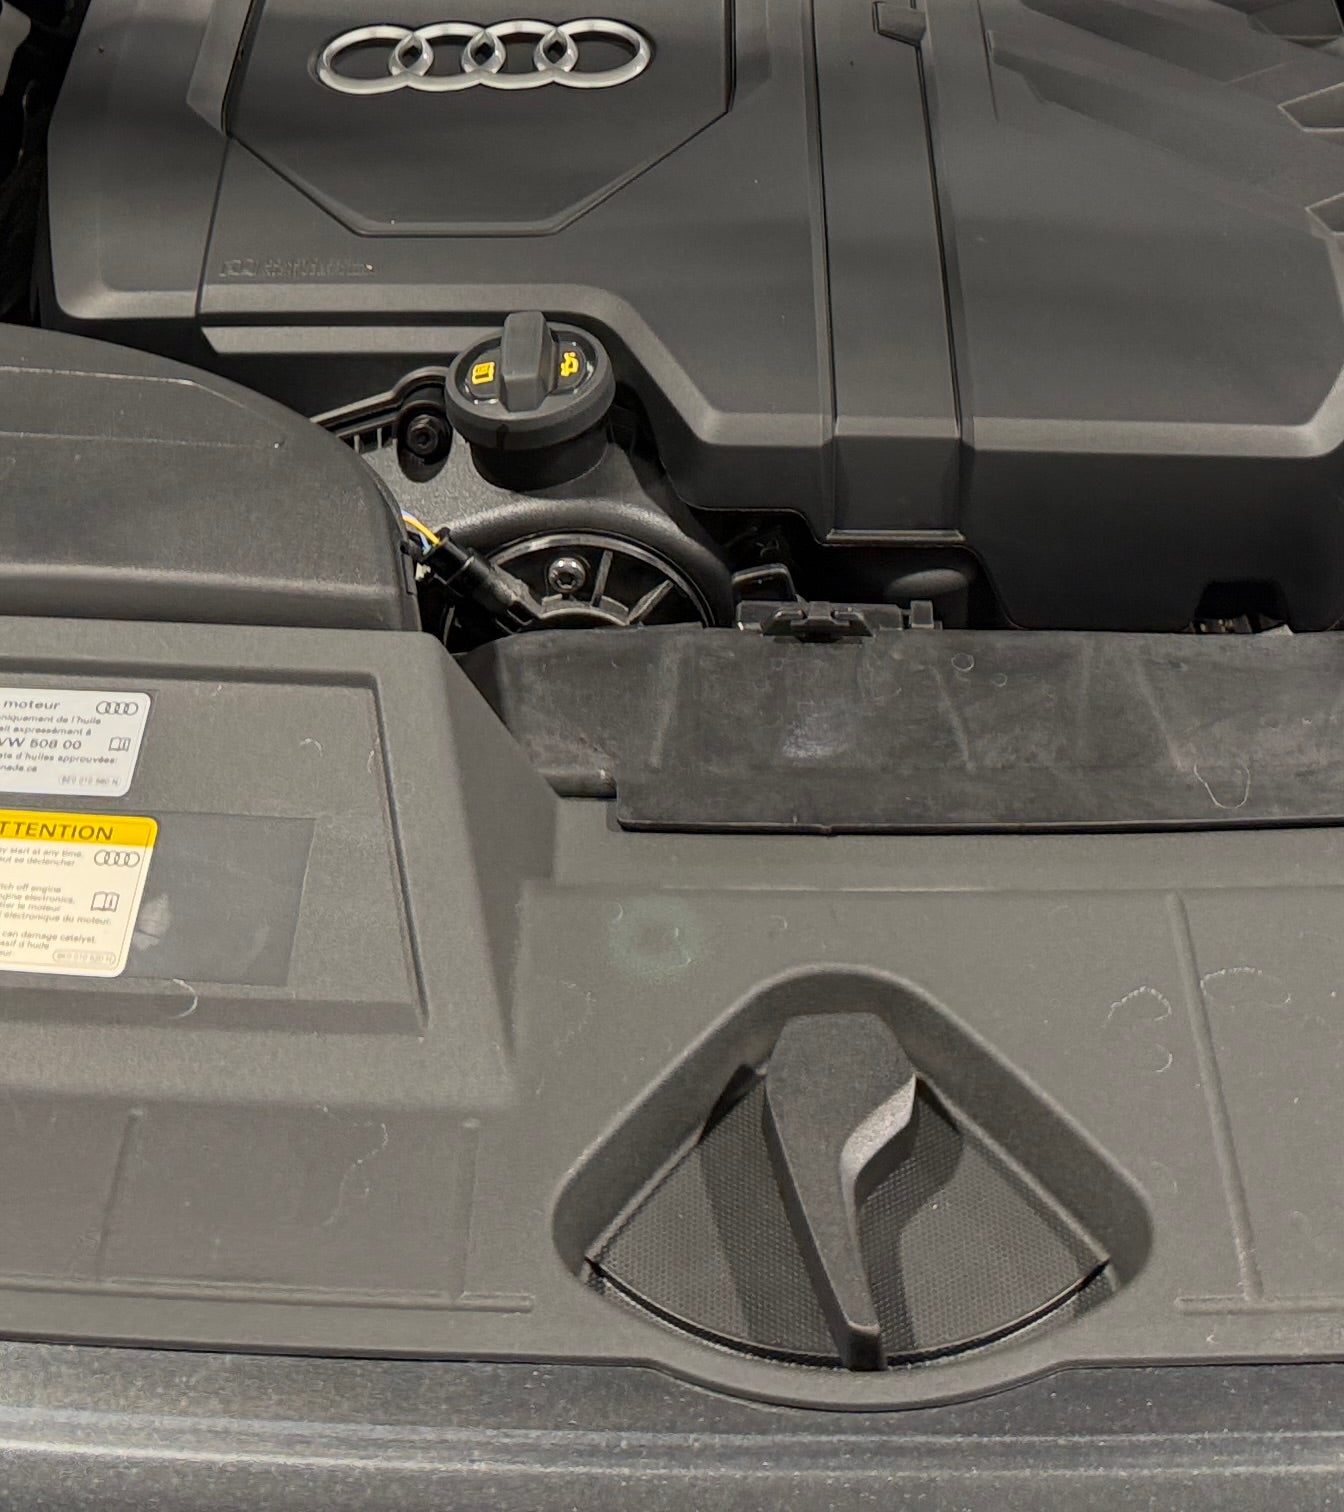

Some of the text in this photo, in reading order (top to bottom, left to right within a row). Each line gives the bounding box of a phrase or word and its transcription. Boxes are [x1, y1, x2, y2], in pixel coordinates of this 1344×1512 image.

[3, 700, 59, 709] moteur
[55, 715, 68, 723] de
[29, 738, 58, 748] 508
[62, 739, 82, 750] 00
